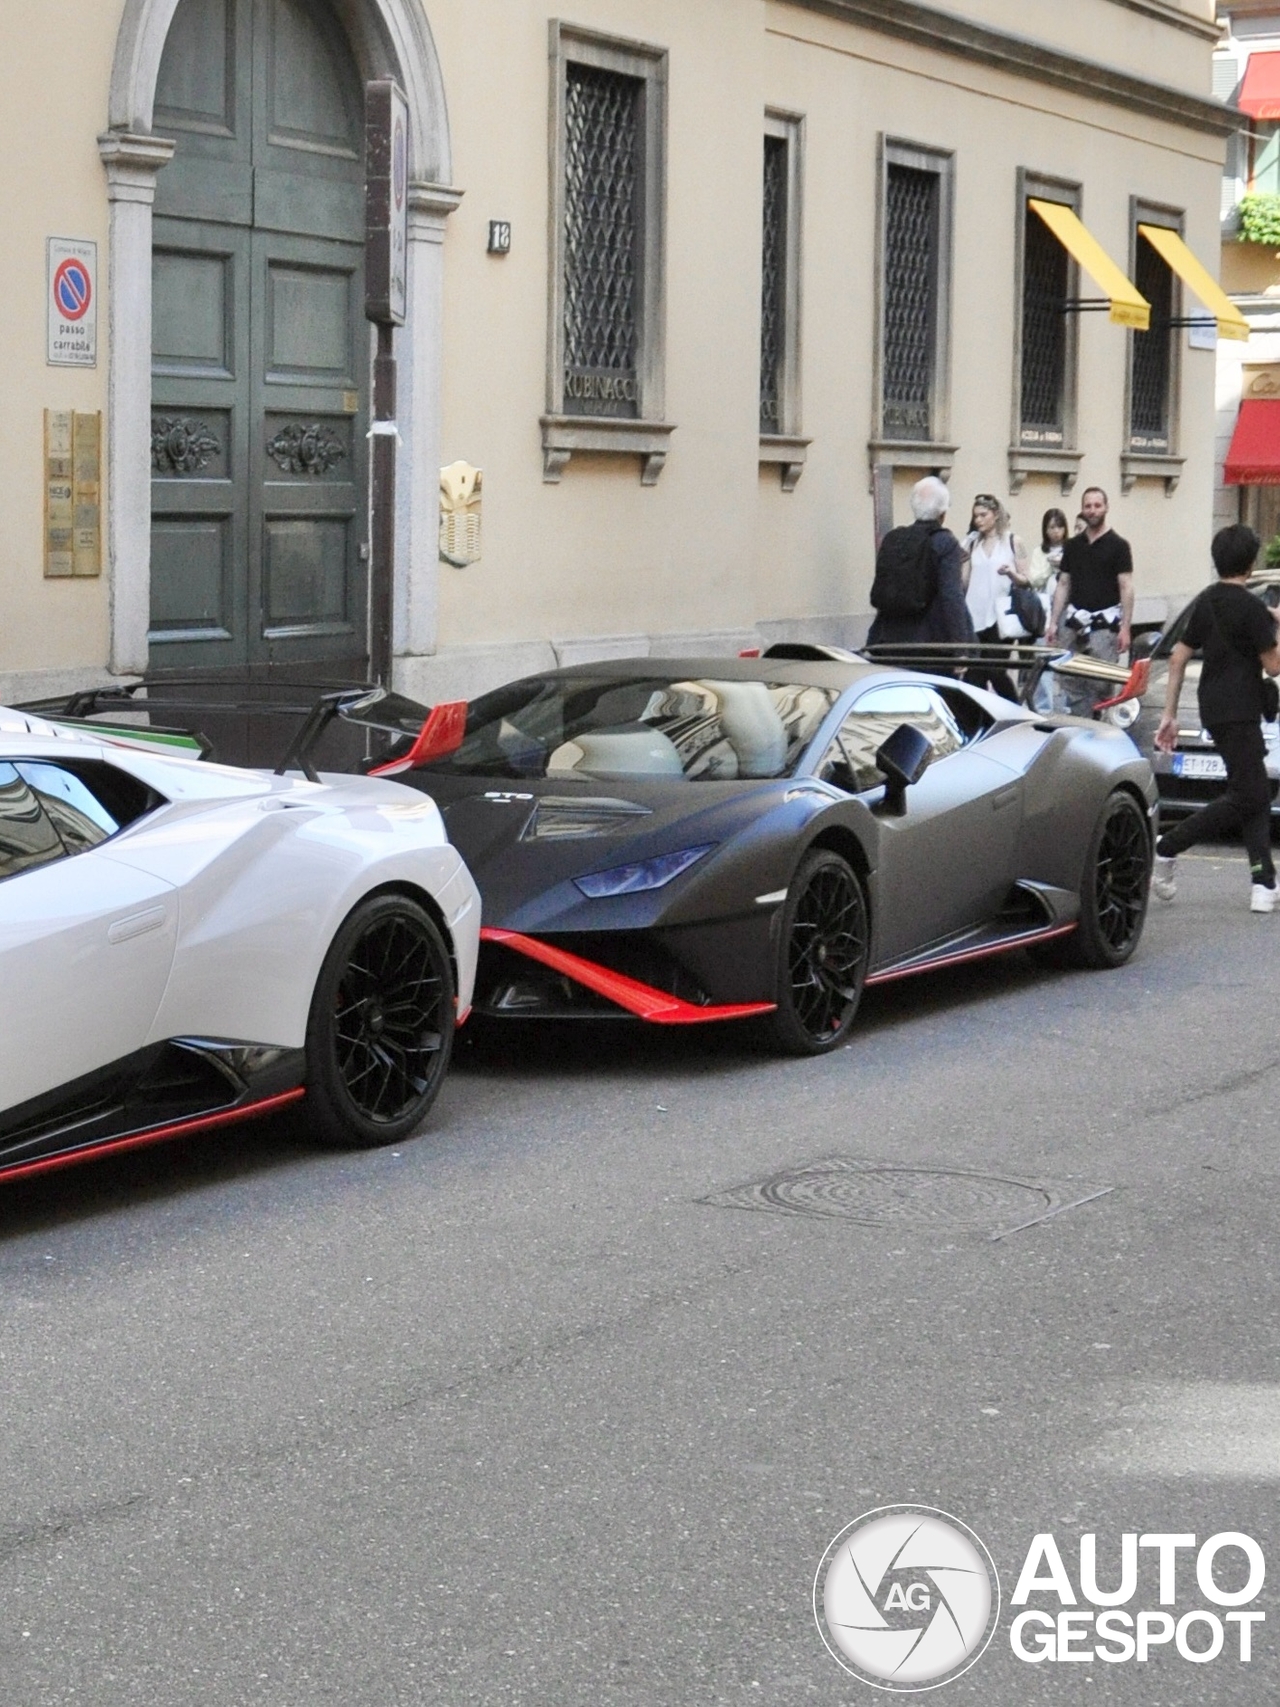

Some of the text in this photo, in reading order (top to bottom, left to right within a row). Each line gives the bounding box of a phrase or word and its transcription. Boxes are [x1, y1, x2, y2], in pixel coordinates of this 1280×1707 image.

[493, 223, 510, 248] 18
[59, 324, 85, 336] passo
[53, 339, 91, 352] carrabile
[484, 791, 534, 800] STO
